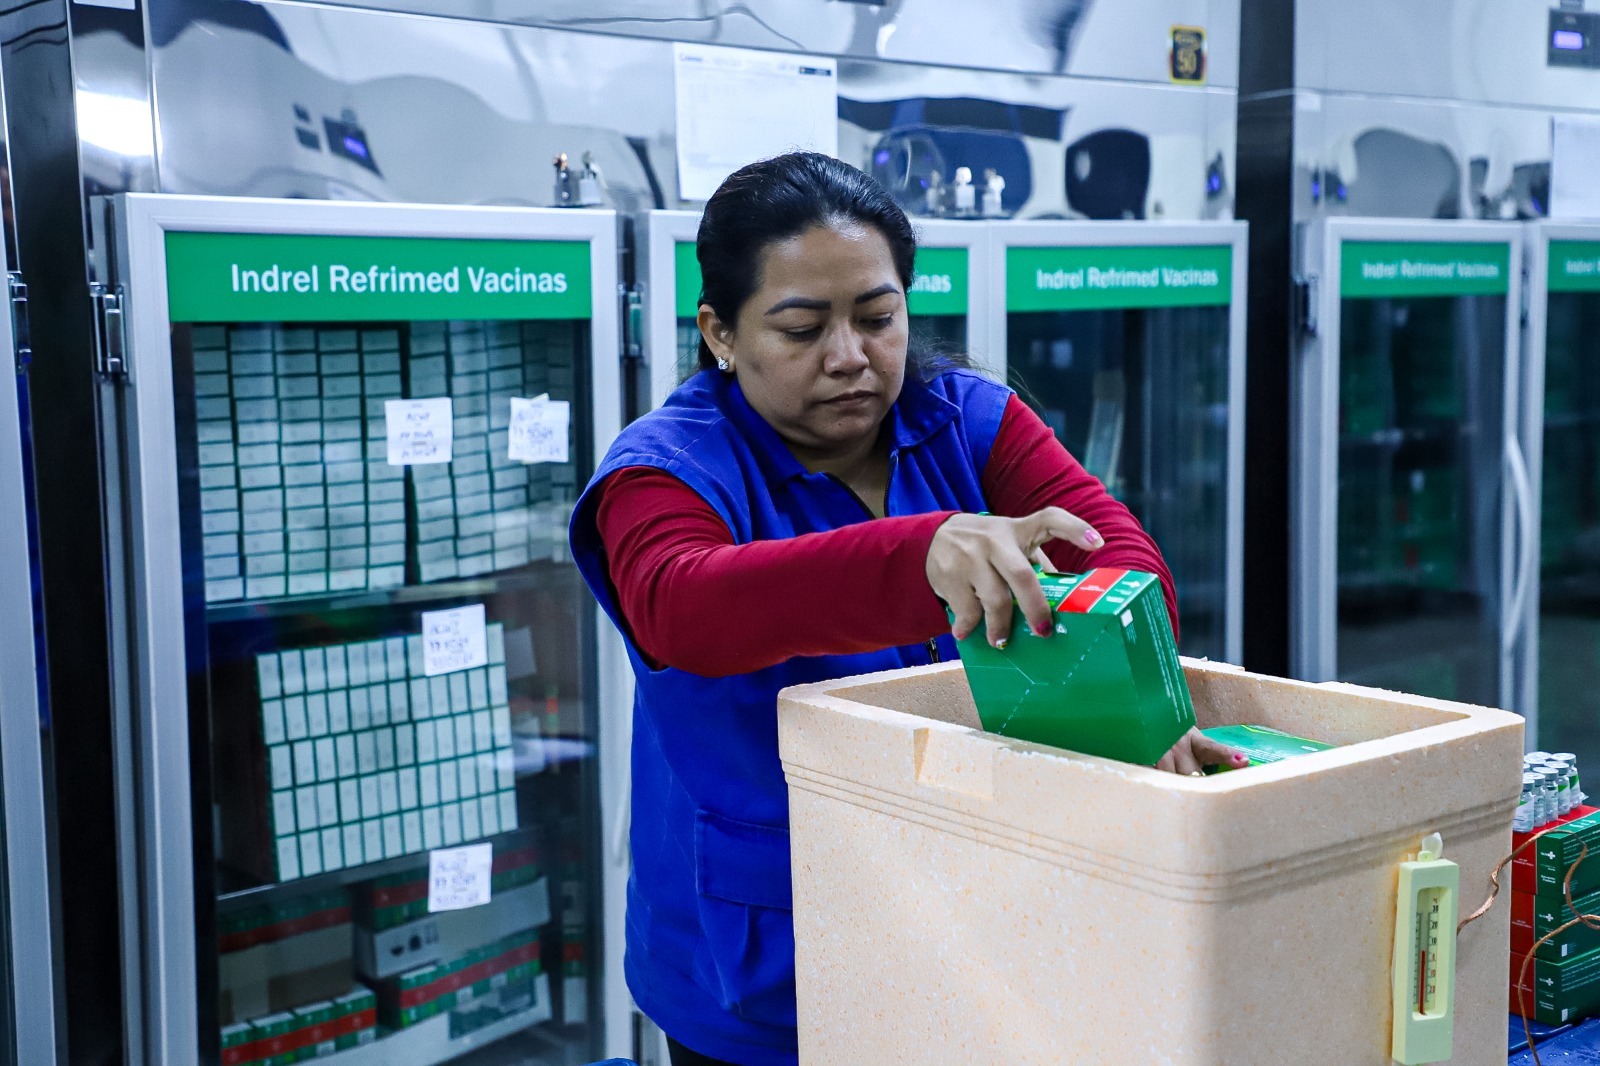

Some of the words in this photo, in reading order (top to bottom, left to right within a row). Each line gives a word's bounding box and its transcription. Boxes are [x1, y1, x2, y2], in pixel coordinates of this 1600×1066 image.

[231, 264, 318, 292] Indrel
[329, 265, 460, 293] Refrimed
[467, 266, 567, 293] Vacinas
[1036, 269, 1084, 289] Indrel
[1087, 268, 1159, 289] Refrimed
[1163, 268, 1218, 287] Vacinas
[1432, 921, 1438, 929] 20
[1431, 937, 1437, 945] 10
